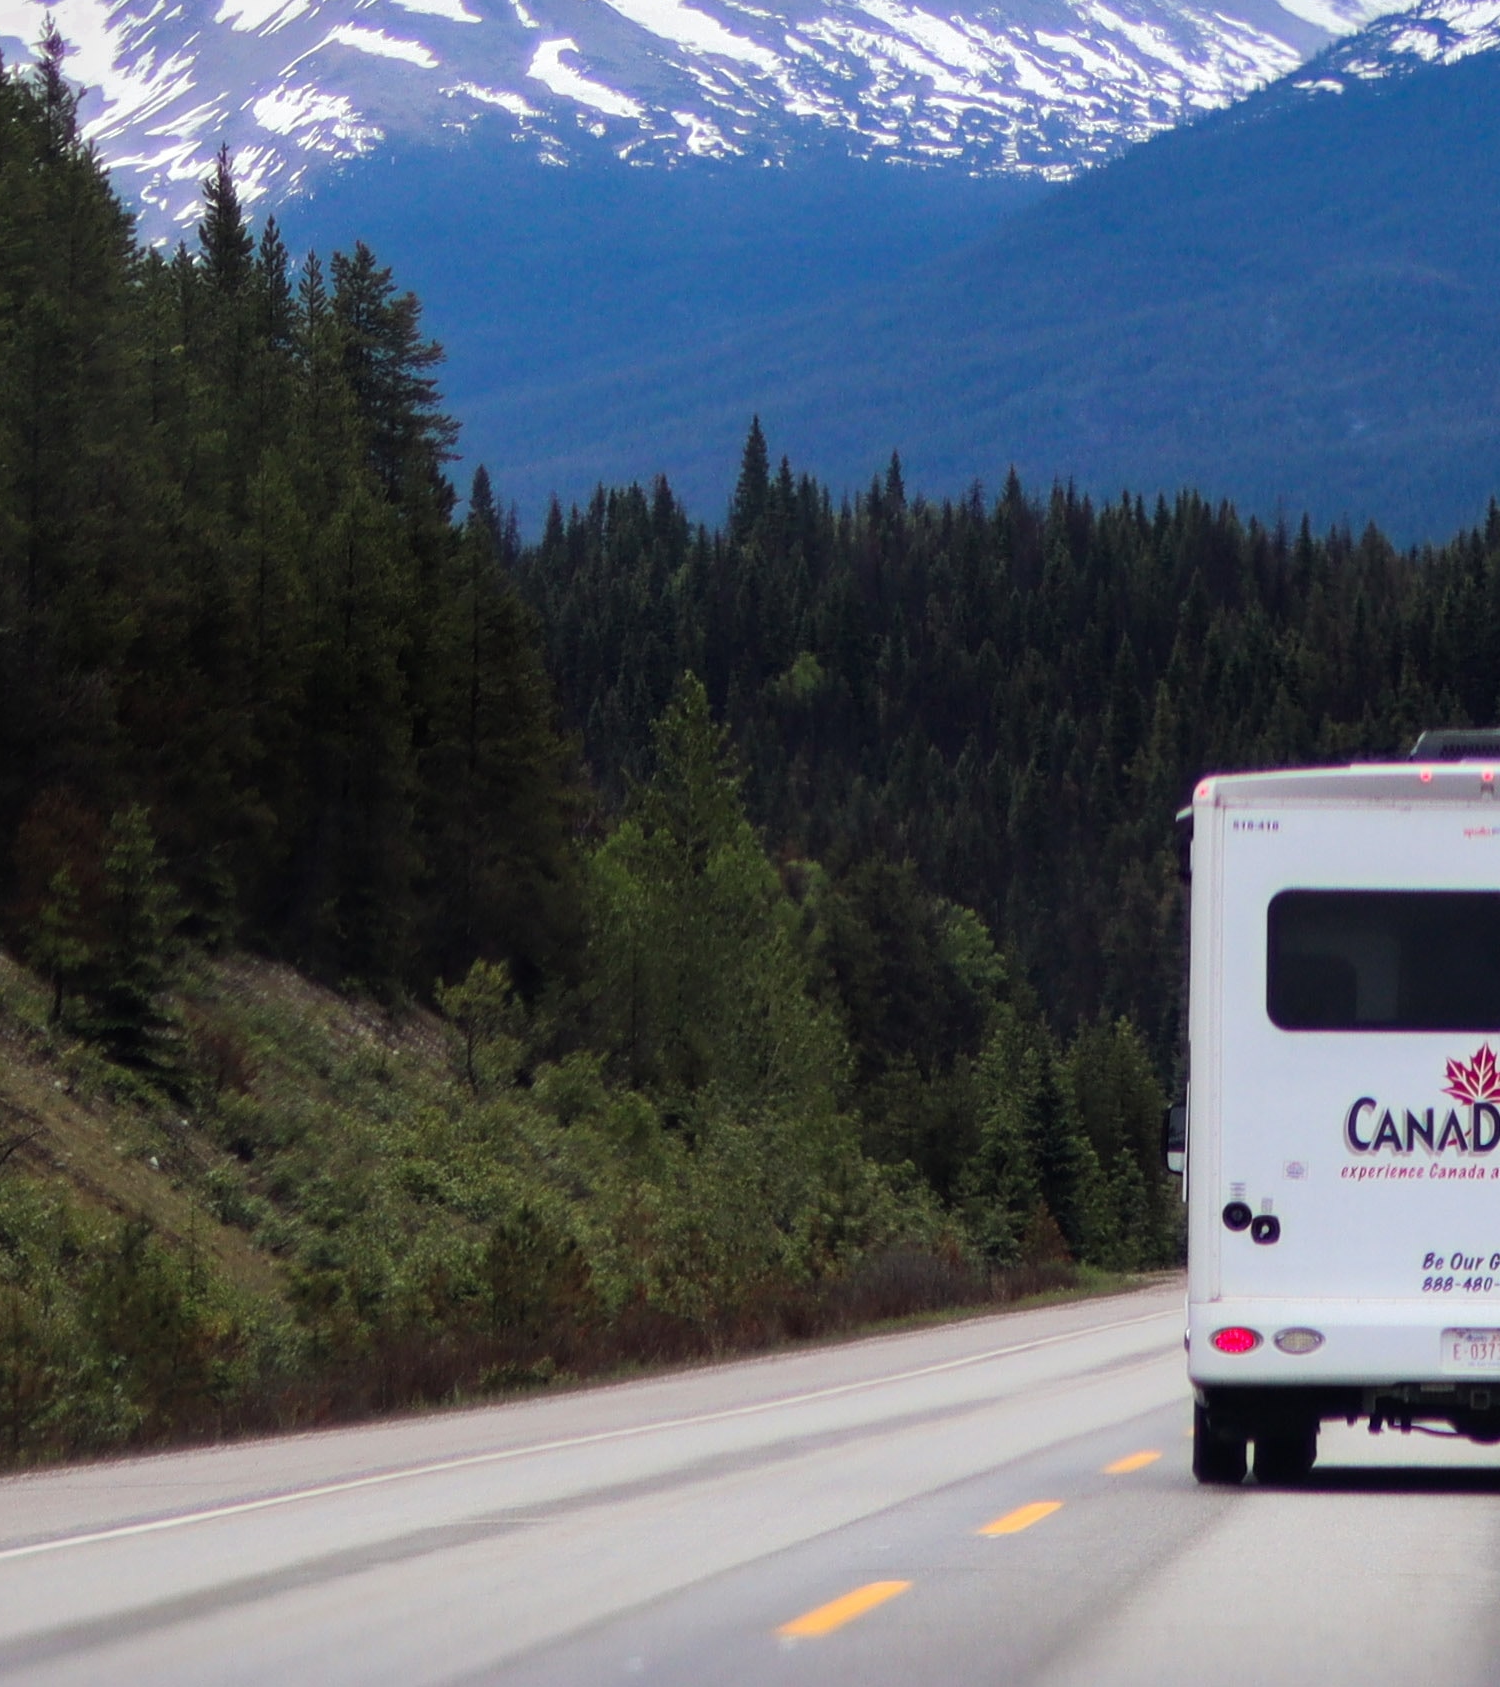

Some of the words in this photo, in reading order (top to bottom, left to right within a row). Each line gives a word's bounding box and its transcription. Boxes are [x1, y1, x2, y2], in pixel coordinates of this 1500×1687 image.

[1341, 1164, 1424, 1182] experience
[1429, 1162, 1485, 1179] Canada
[1422, 1252, 1444, 1271] Be
[1450, 1252, 1484, 1271] Our
